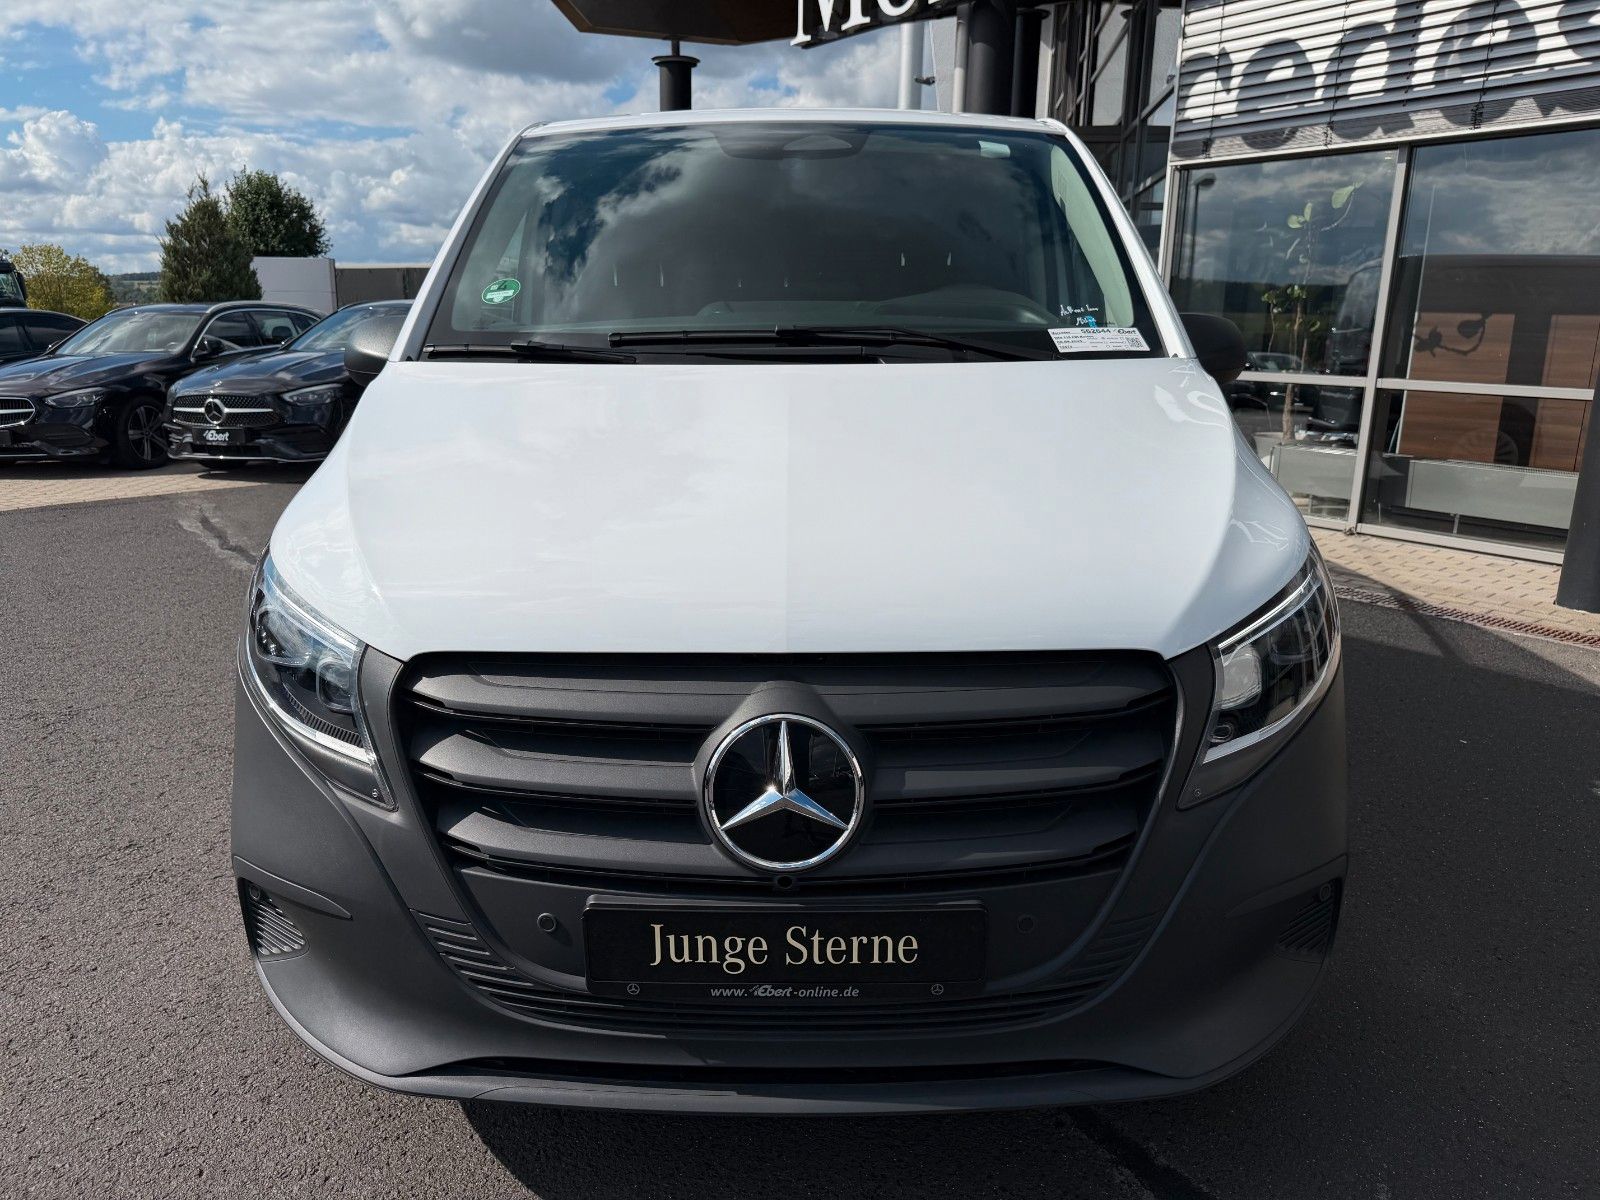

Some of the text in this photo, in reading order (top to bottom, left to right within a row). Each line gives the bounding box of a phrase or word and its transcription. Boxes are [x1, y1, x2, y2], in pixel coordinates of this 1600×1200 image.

[203, 429, 230, 441] Ebert
[649, 923, 919, 975] Junge Sterne
[709, 984, 860, 998] www.Ebert-online.de
